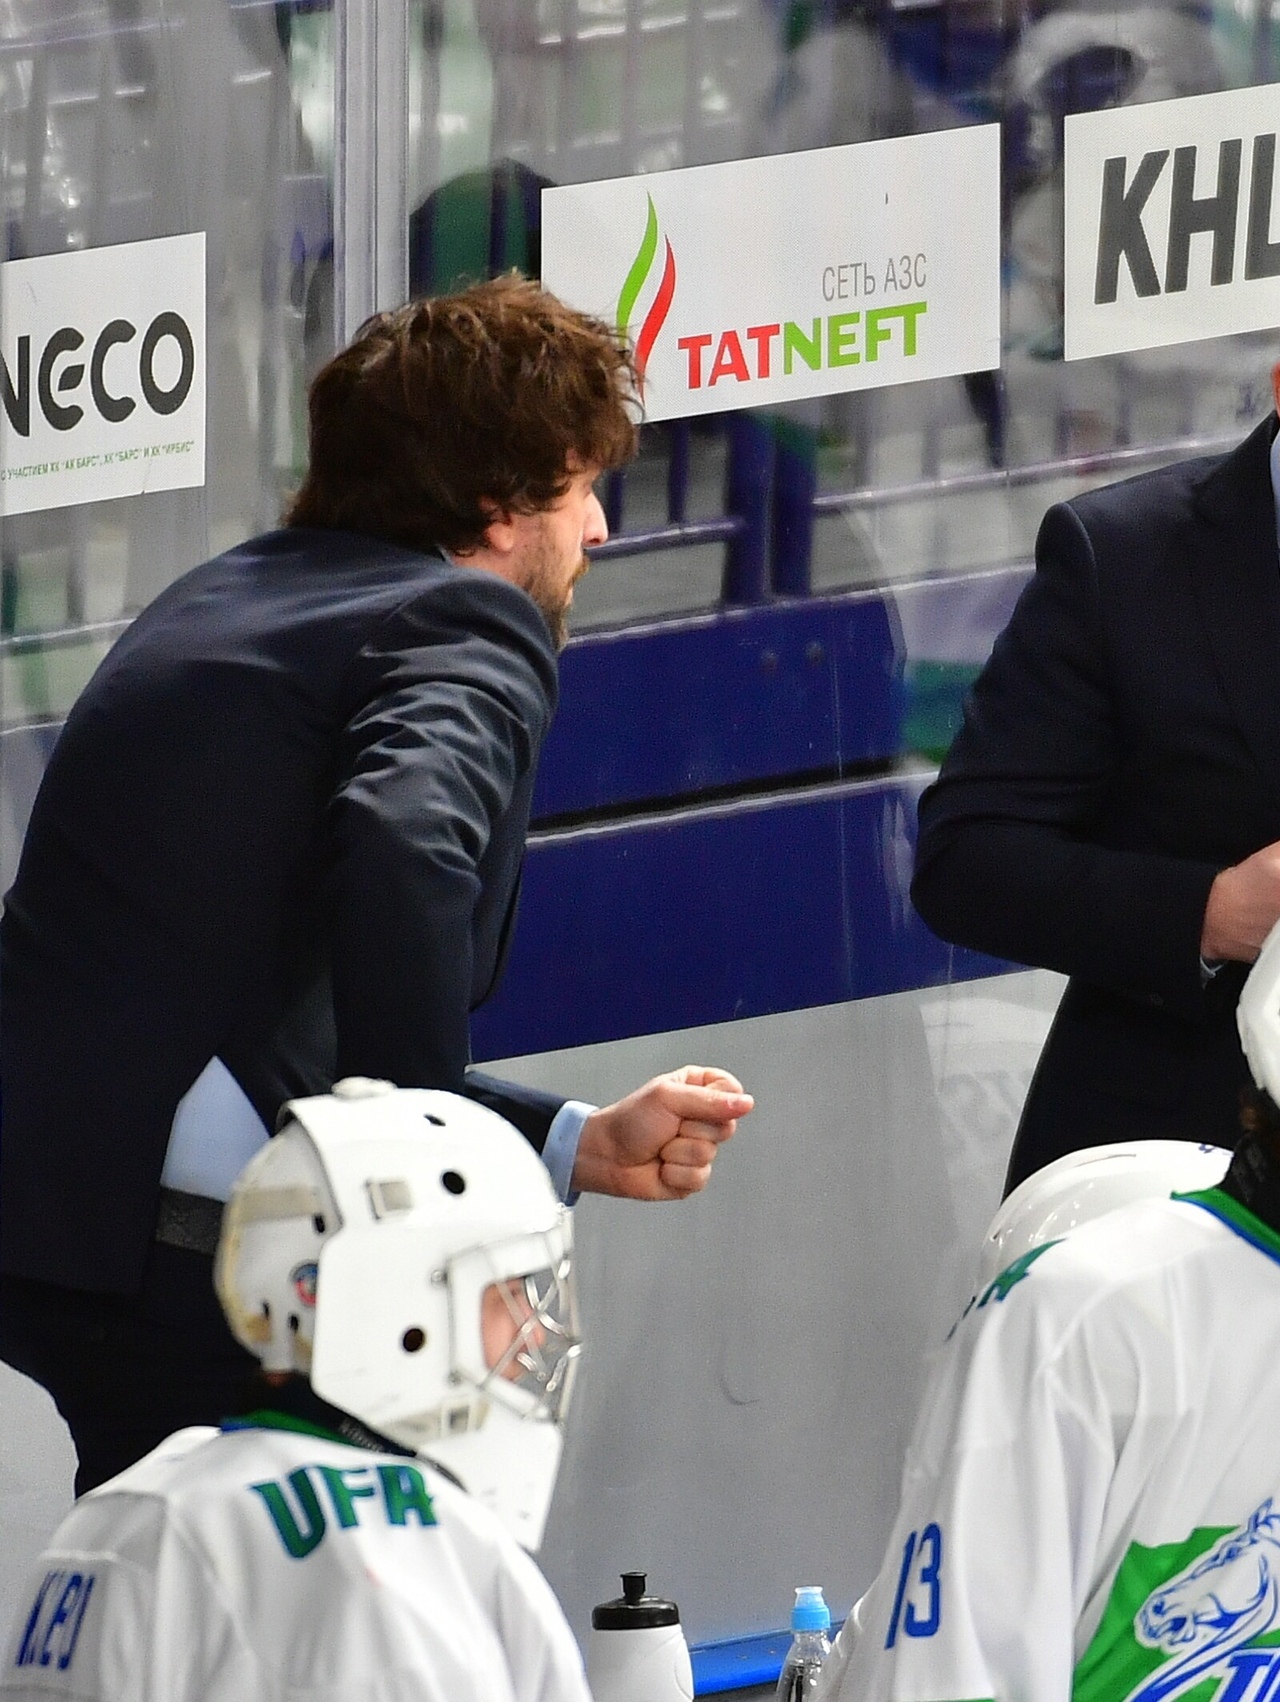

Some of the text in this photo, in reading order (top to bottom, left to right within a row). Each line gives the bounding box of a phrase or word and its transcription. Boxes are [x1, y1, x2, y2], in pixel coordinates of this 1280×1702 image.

[822, 253, 927, 301] СЕТЬ АЗС
[678, 301, 927, 389] TATNEFT
[250, 1464, 438, 1560] UFA
[884, 1522, 941, 1650] 13
